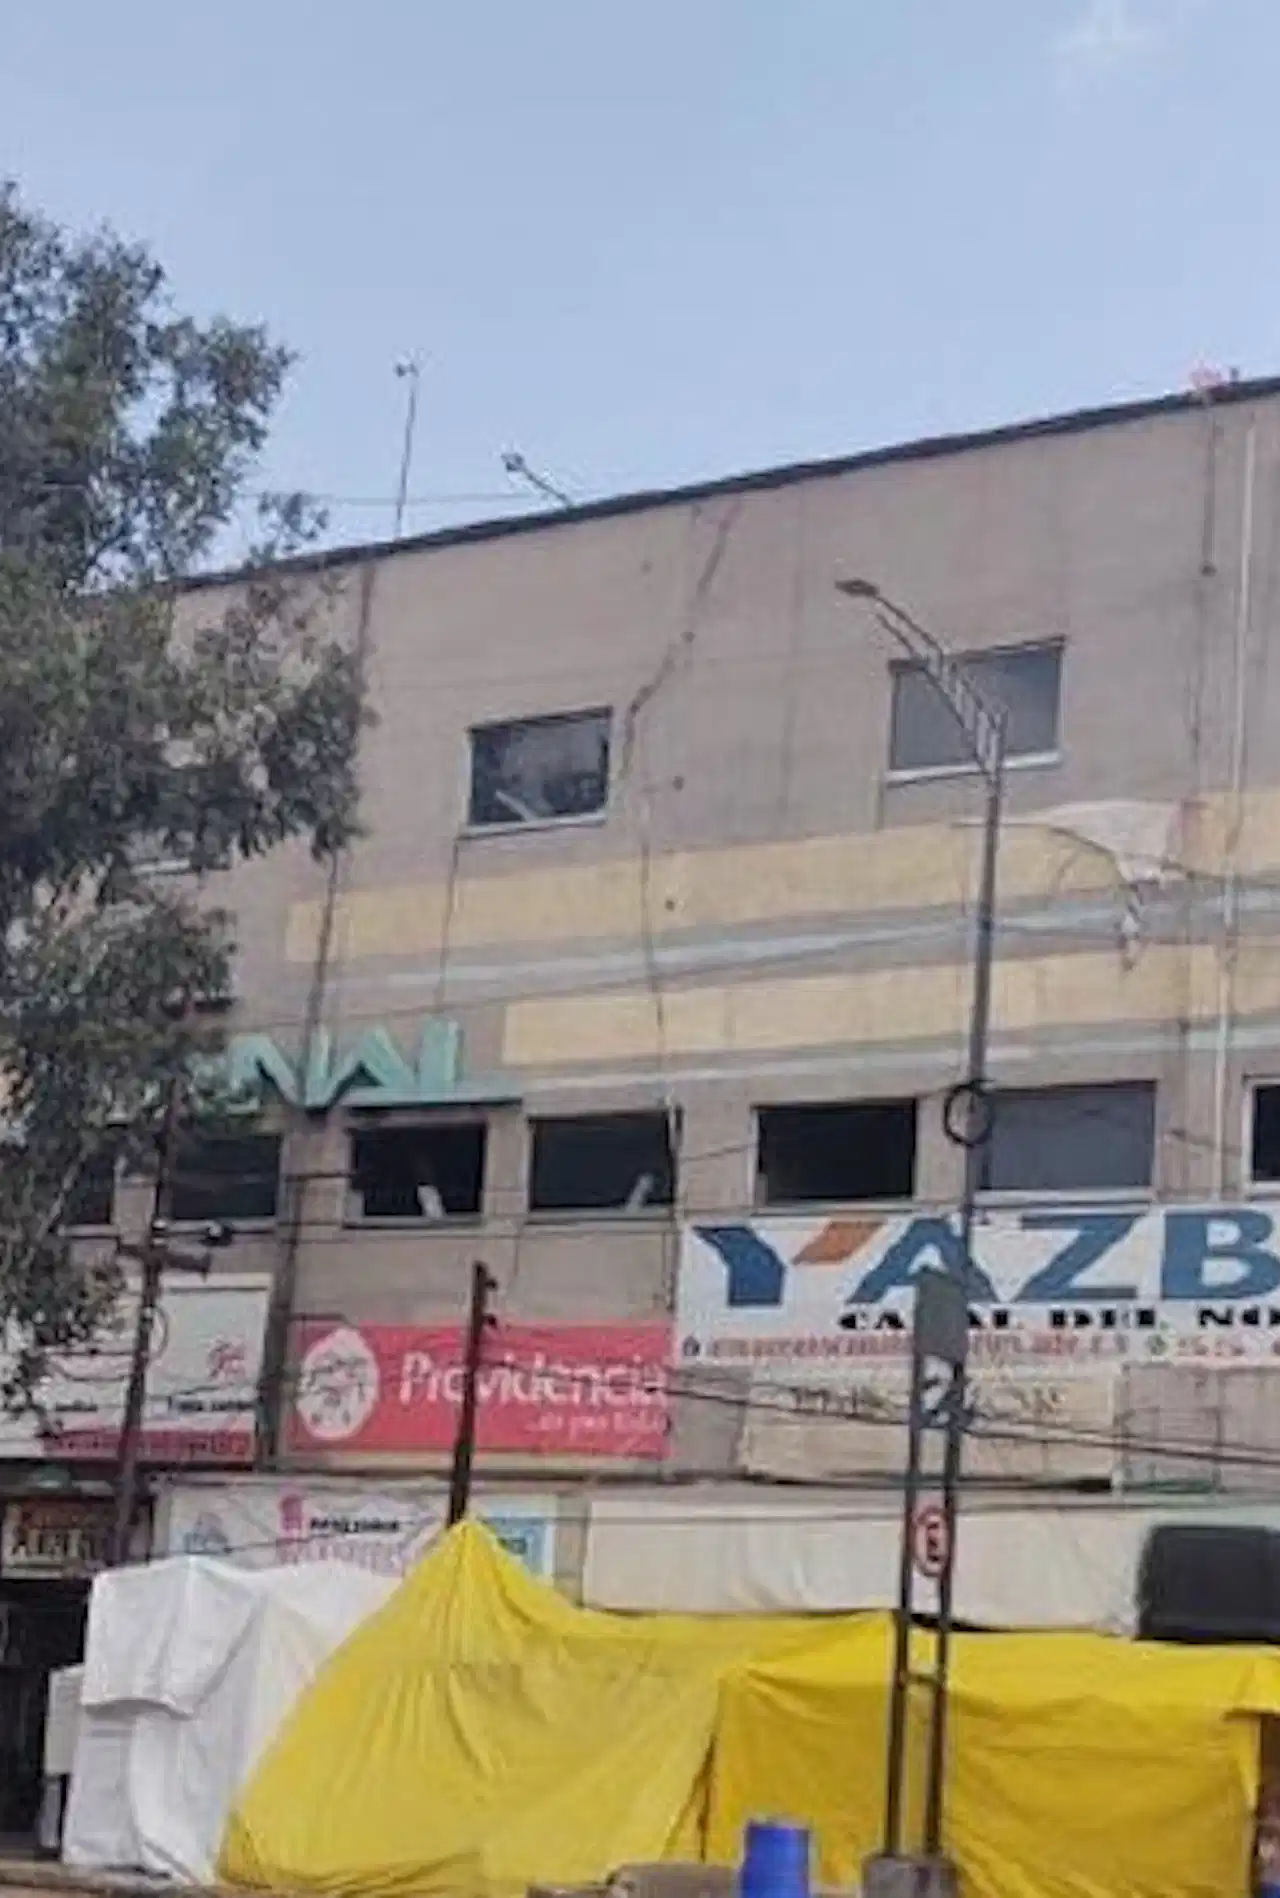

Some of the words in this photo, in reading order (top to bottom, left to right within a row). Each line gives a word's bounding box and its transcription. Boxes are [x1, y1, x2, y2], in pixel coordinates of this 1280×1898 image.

[837, 1307, 1023, 1331] CAAL
[1048, 1307, 1166, 1330] DEL
[400, 1350, 669, 1407] Providencia
